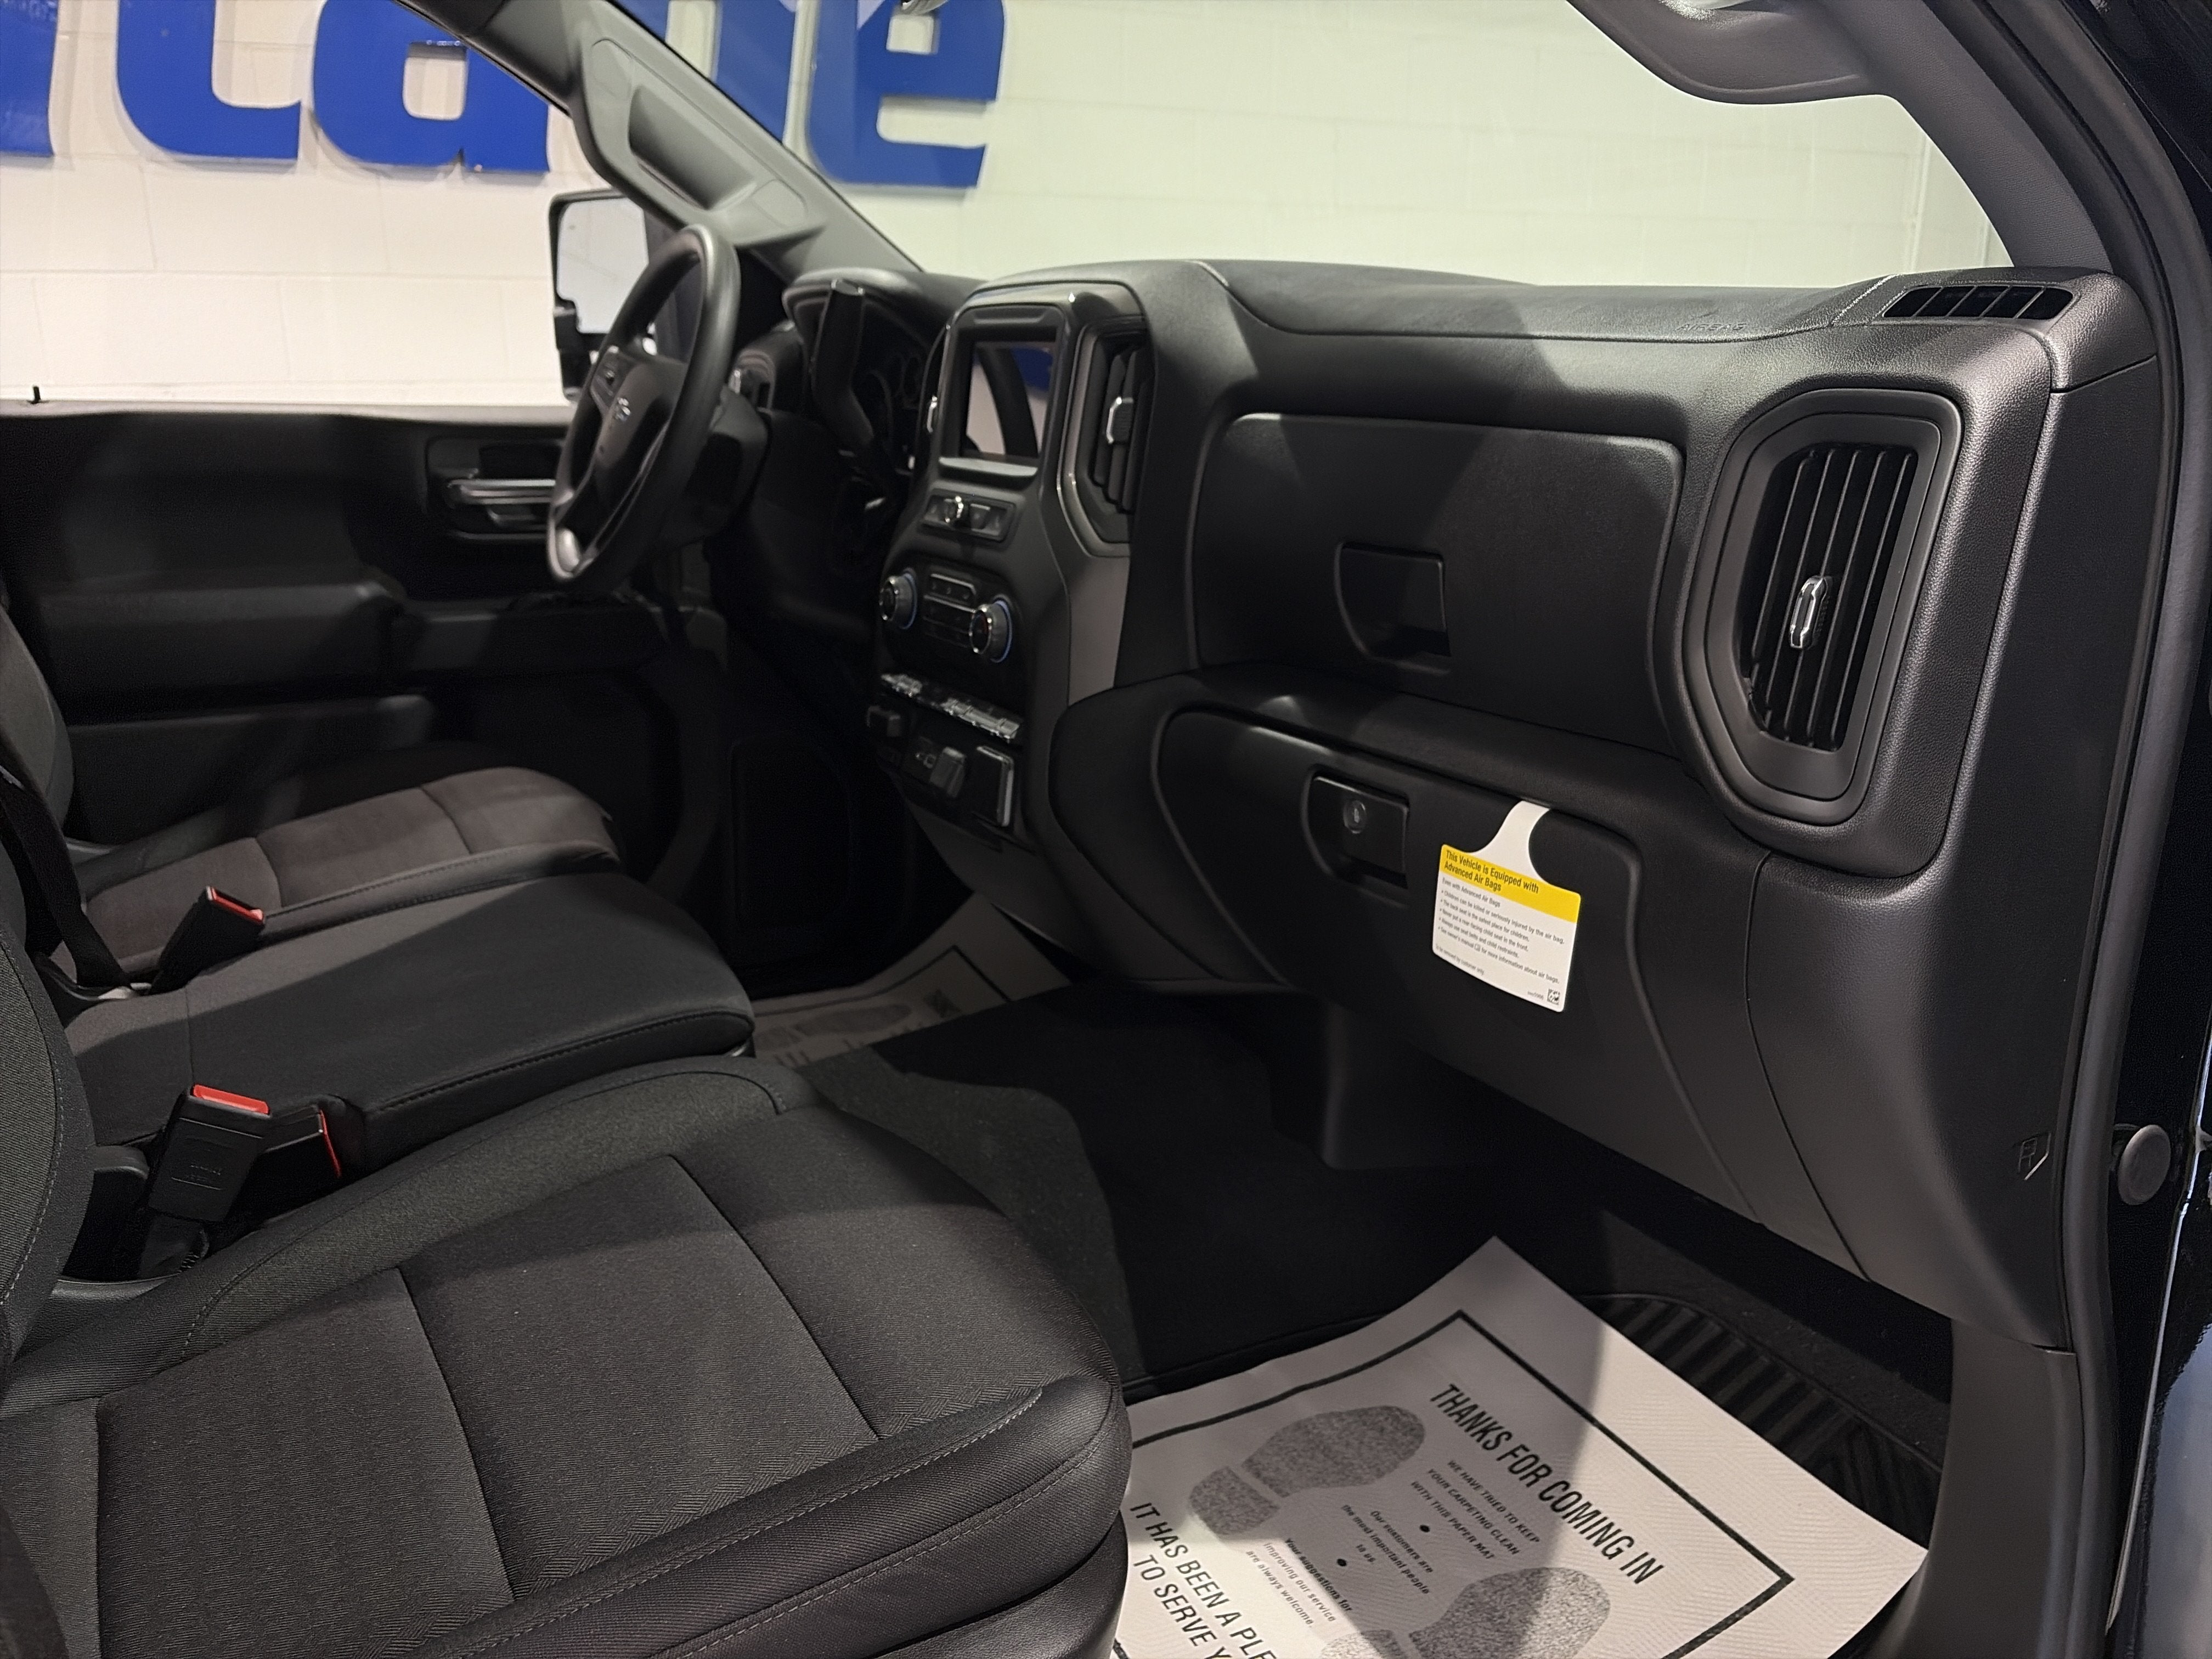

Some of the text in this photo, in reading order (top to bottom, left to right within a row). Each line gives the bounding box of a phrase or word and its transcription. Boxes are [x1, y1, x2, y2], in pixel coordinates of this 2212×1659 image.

[1444, 861, 1501, 891] Advanced Air Bags
[1447, 850, 1538, 893] This Vehicle is Equipped with
[1411, 1481, 1494, 1559] WITH THIS PAPER MAT
[1427, 1469, 1520, 1555] YOUR CARPETING CLEAN
[1430, 1384, 1664, 1584] THANKS FOR COMING IN
[1447, 1460, 1539, 1542] WE HAVE TRIED TO KEEP
[1130, 1502, 1160, 1522] IT
[1145, 1521, 1188, 1558] HAS
[1176, 1560, 1231, 1610] BEEN
[1215, 1611, 1243, 1627] A
[1285, 1538, 1352, 1611] Your suggestions for
[1341, 1505, 1429, 1594] the most important people
[1370, 1511, 1433, 1572] Our customers are
[1133, 1555, 1166, 1582] TO
[1154, 1583, 1217, 1647] SERVE
[1246, 1551, 1313, 1627] are always welcome.
[1264, 1543, 1336, 1621] improving our service
